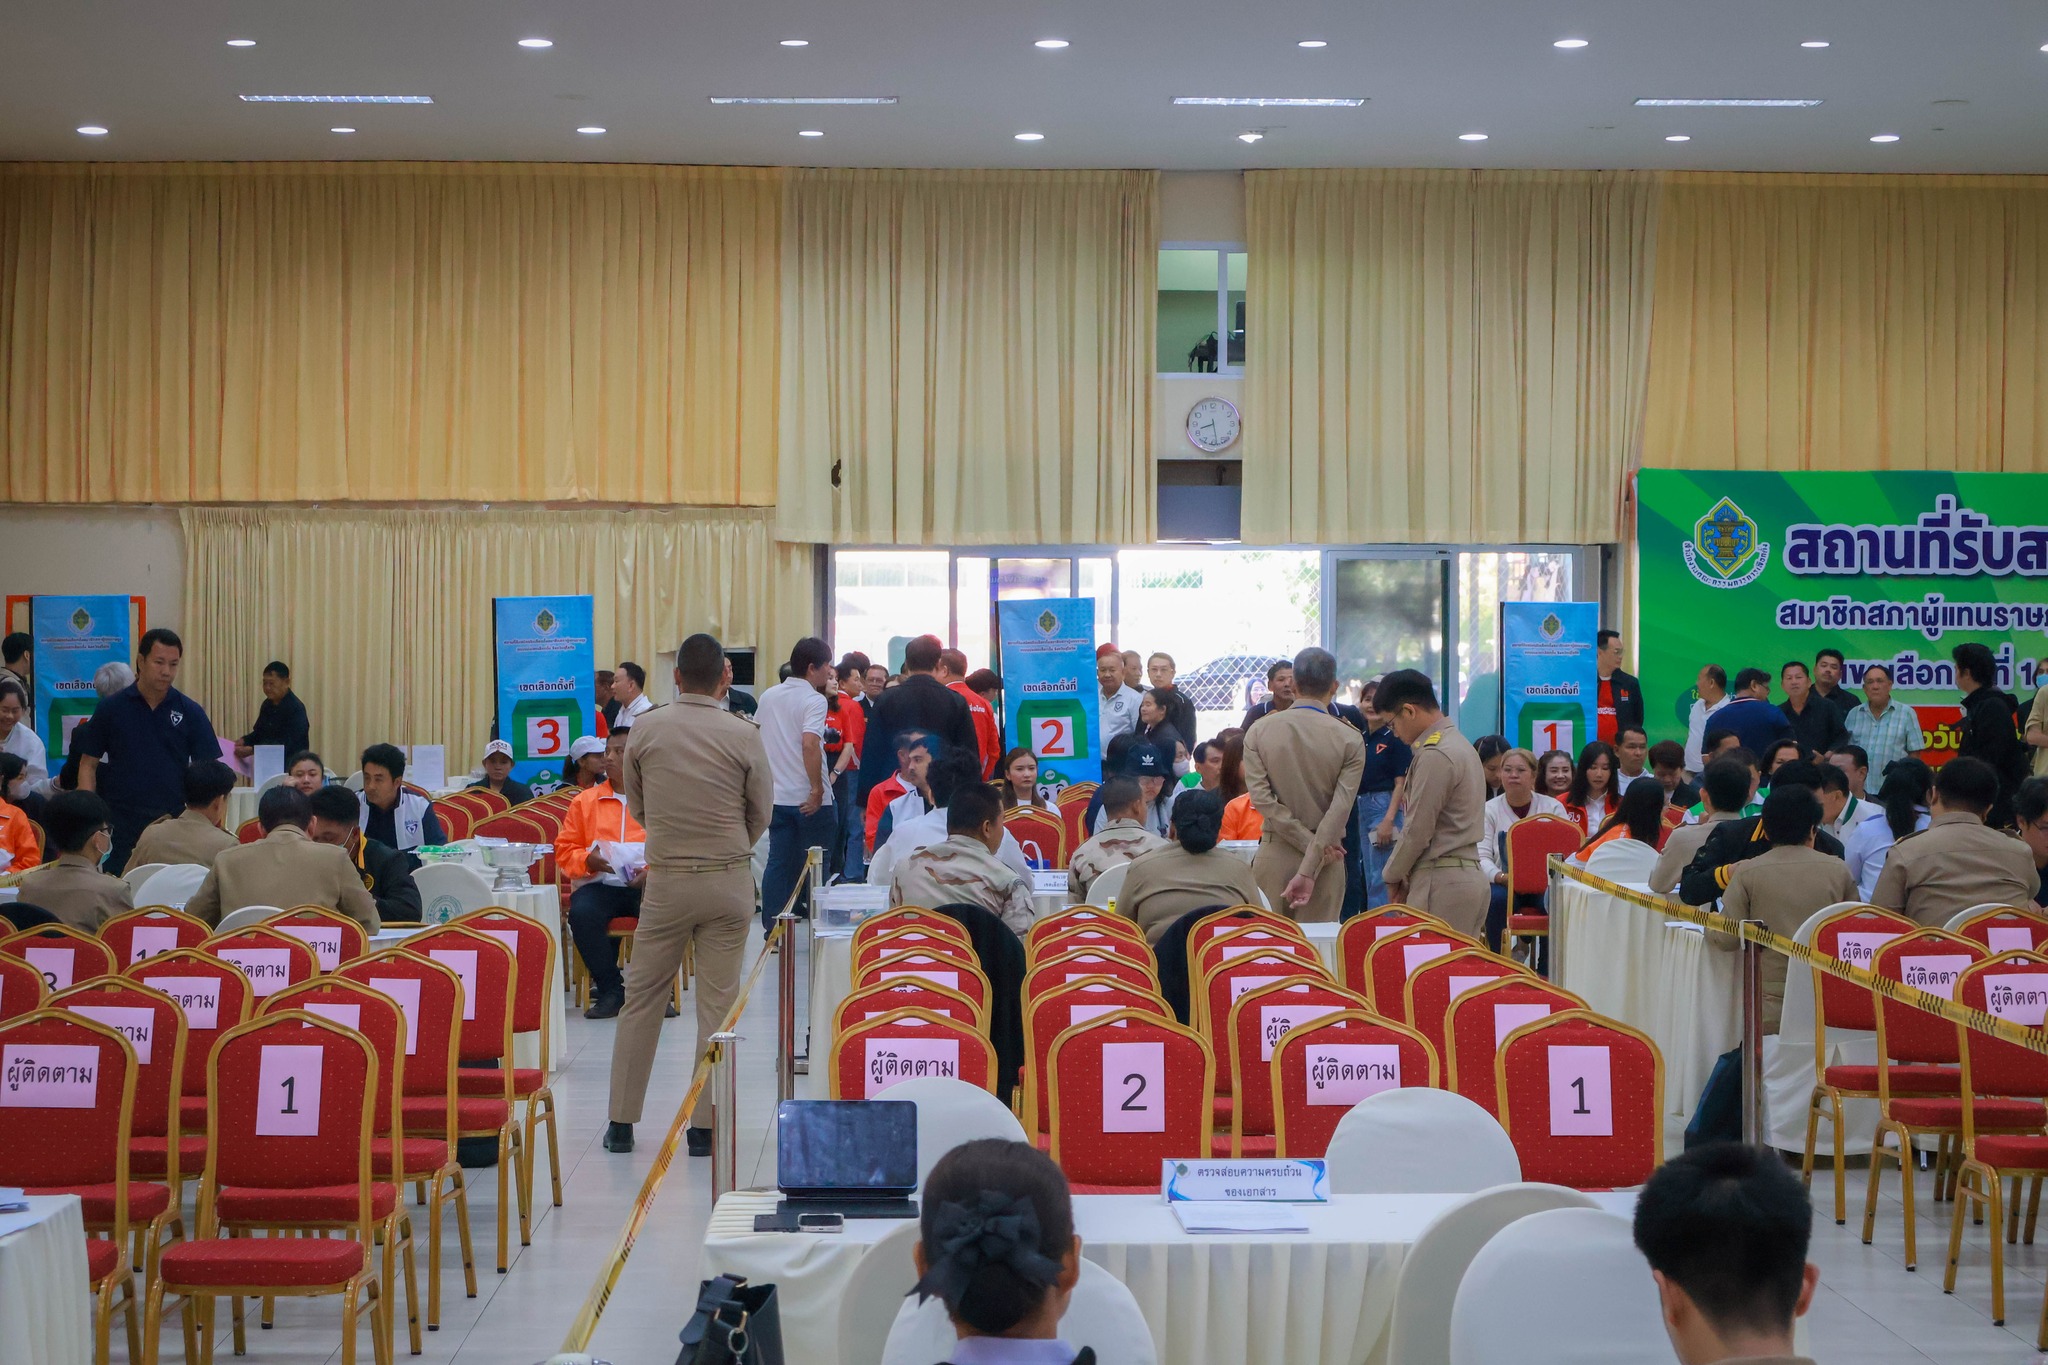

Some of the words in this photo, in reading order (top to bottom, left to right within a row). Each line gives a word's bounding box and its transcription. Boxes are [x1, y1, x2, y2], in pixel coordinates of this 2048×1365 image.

[519, 677, 575, 692] เขตเลือกตั้งที่
[1023, 678, 1077, 692] เขตเลือกตั้งที่
[1526, 682, 1579, 695] เขตเลือกตั้งที่
[536, 718, 561, 755] 3
[1041, 719, 1065, 754] 2
[1543, 722, 1558, 751] 1
[7, 1057, 92, 1091] ผู้ติดตาม
[871, 1050, 954, 1084] ผู้ติดตาม
[1312, 1056, 1395, 1089] ผู้ติดตาม
[280, 1076, 298, 1114] 1
[1120, 1073, 1148, 1111] 2
[1570, 1076, 1591, 1114] 1
[1197, 1164, 1302, 1178] ตรวจสอบความครบถ้วน
[1224, 1188, 1277, 1198] ของเอกสาร
